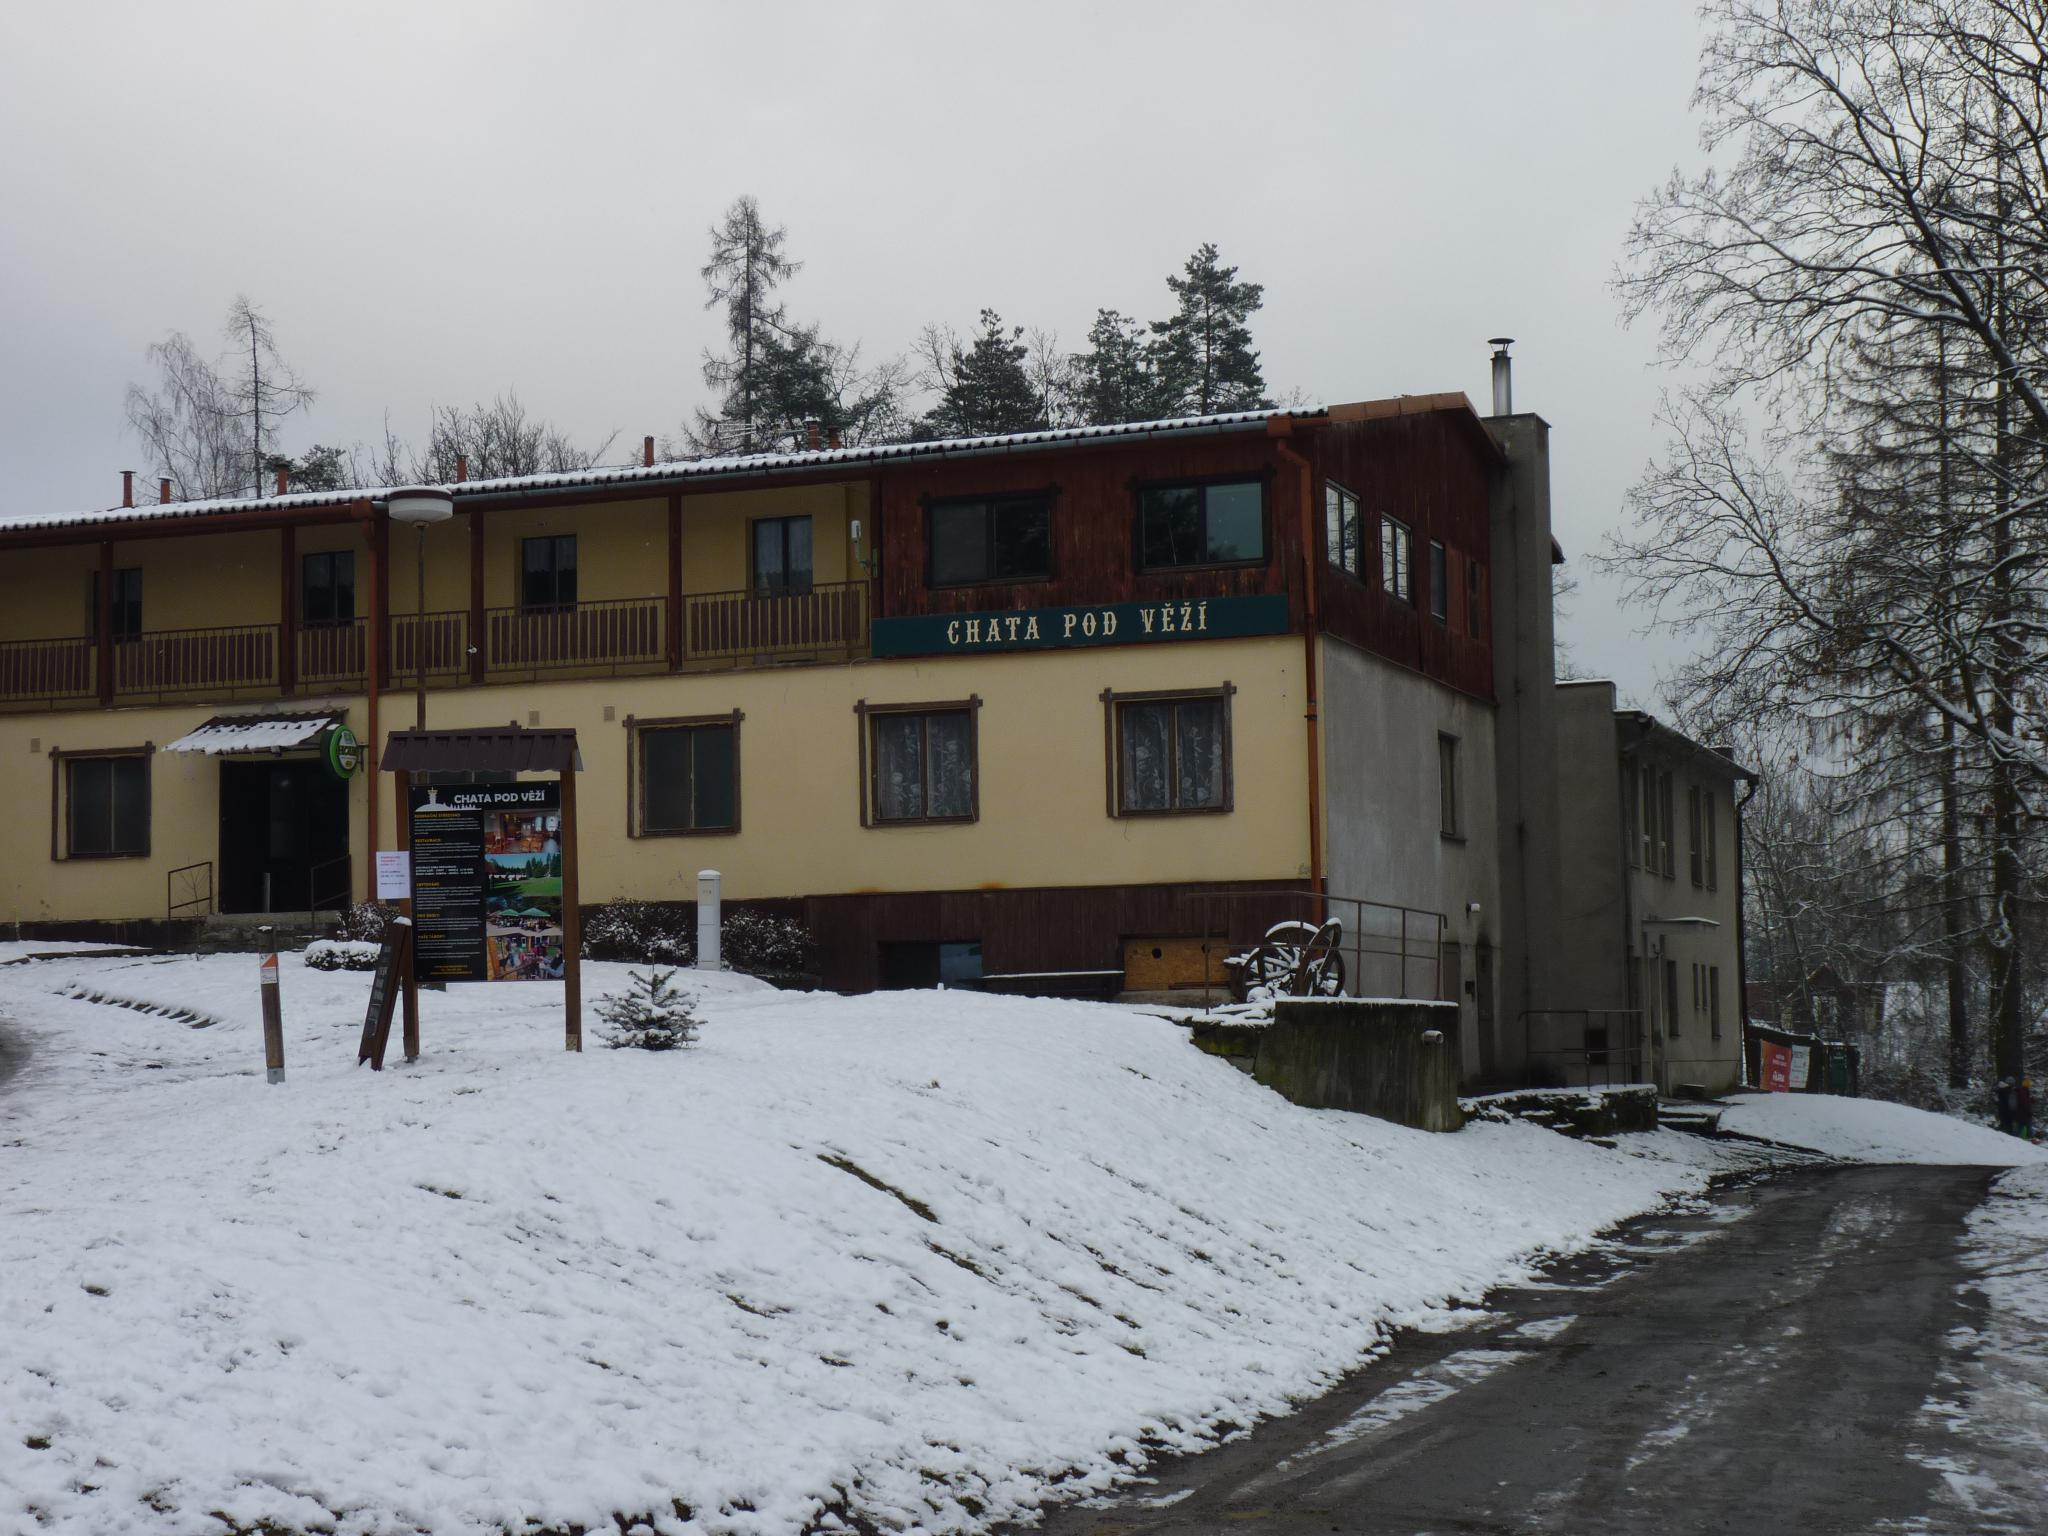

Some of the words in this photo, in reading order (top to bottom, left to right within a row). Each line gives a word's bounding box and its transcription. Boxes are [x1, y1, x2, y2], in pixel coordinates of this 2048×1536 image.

[947, 616, 1040, 645] CHATA
[1063, 611, 1117, 638] POD
[1139, 601, 1208, 633] VĚŽÍ
[454, 793, 492, 804] CHATA
[494, 792, 519, 802] POD
[521, 789, 545, 801] VĚŽÍ
